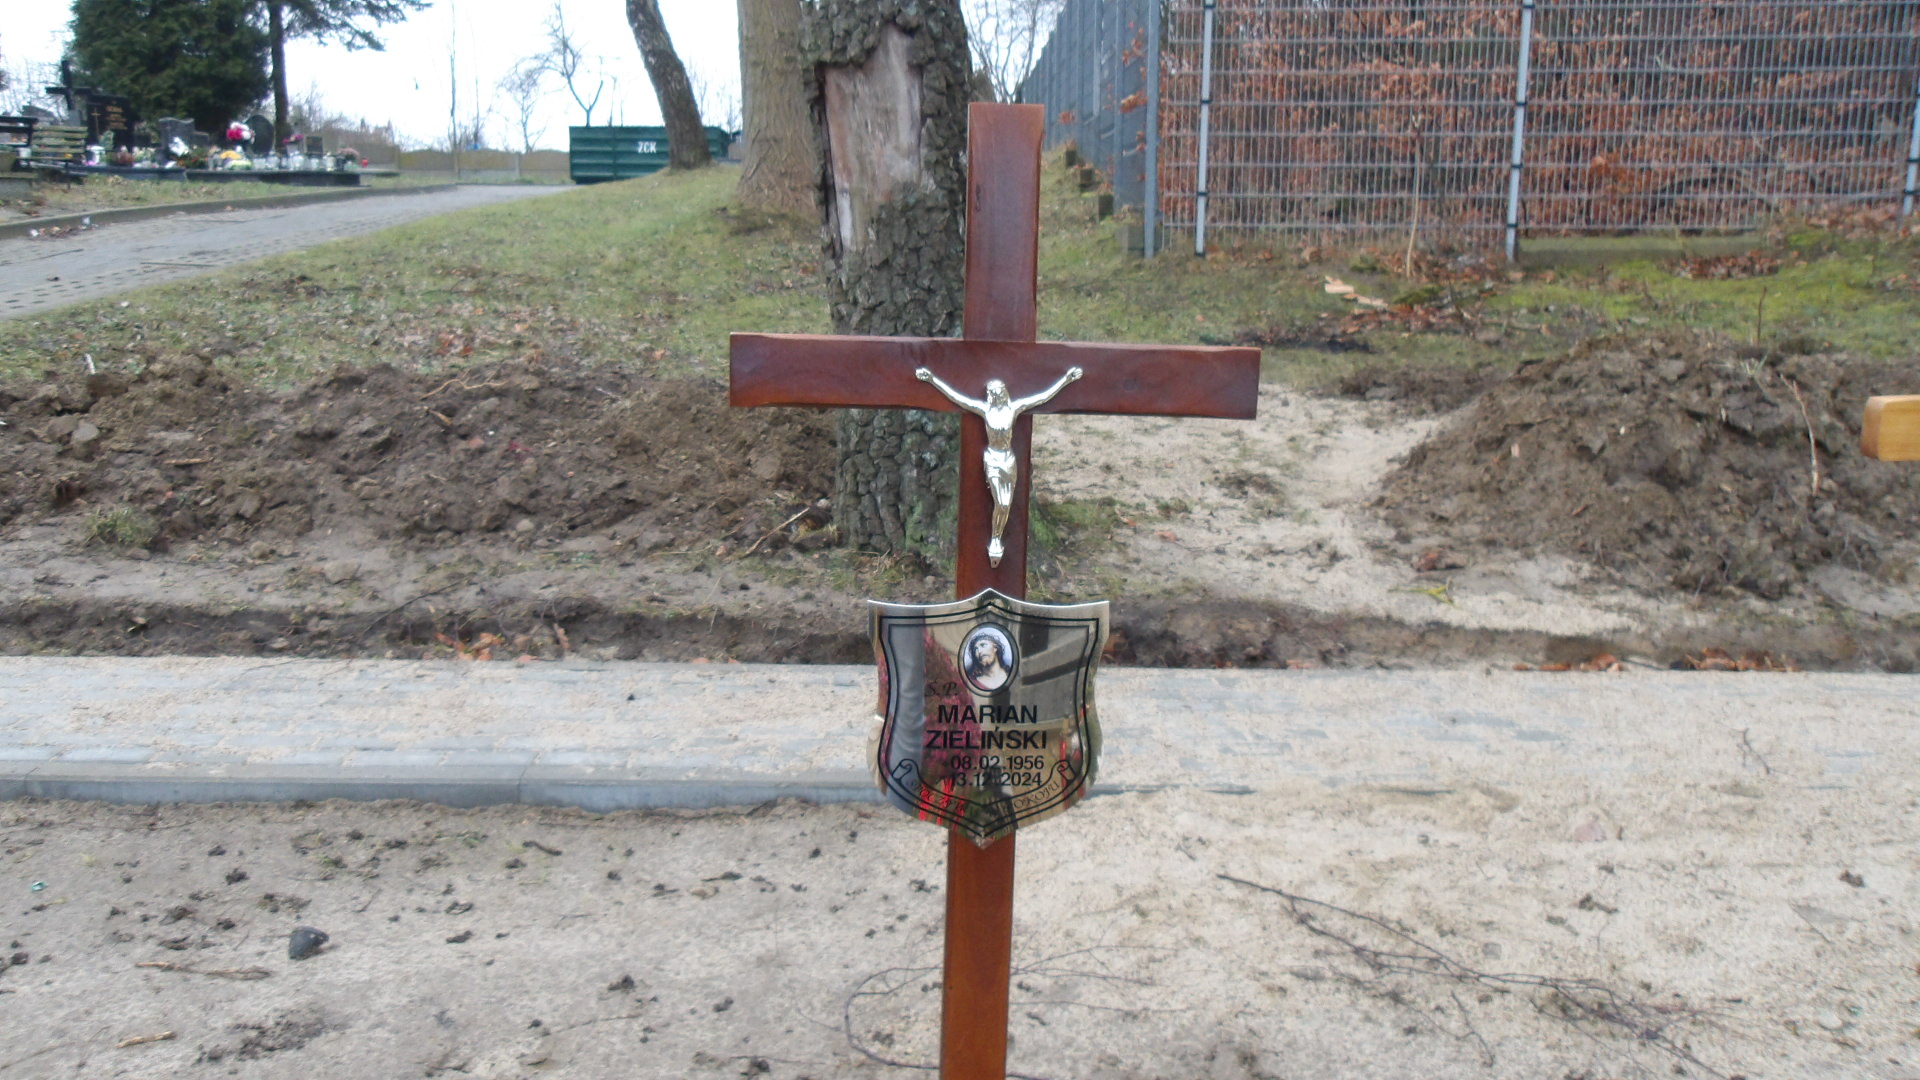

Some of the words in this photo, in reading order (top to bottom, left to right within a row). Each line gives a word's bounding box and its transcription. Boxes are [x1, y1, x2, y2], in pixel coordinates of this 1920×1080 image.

[637, 141, 657, 153] ZCK
[938, 704, 1037, 724] MARIAN
[926, 726, 1047, 750] ZIELIŃSKI
[950, 755, 1044, 770] 08.02.1956
[950, 772, 1042, 787] 13.122024
[1006, 780, 1060, 811] OKOJU
